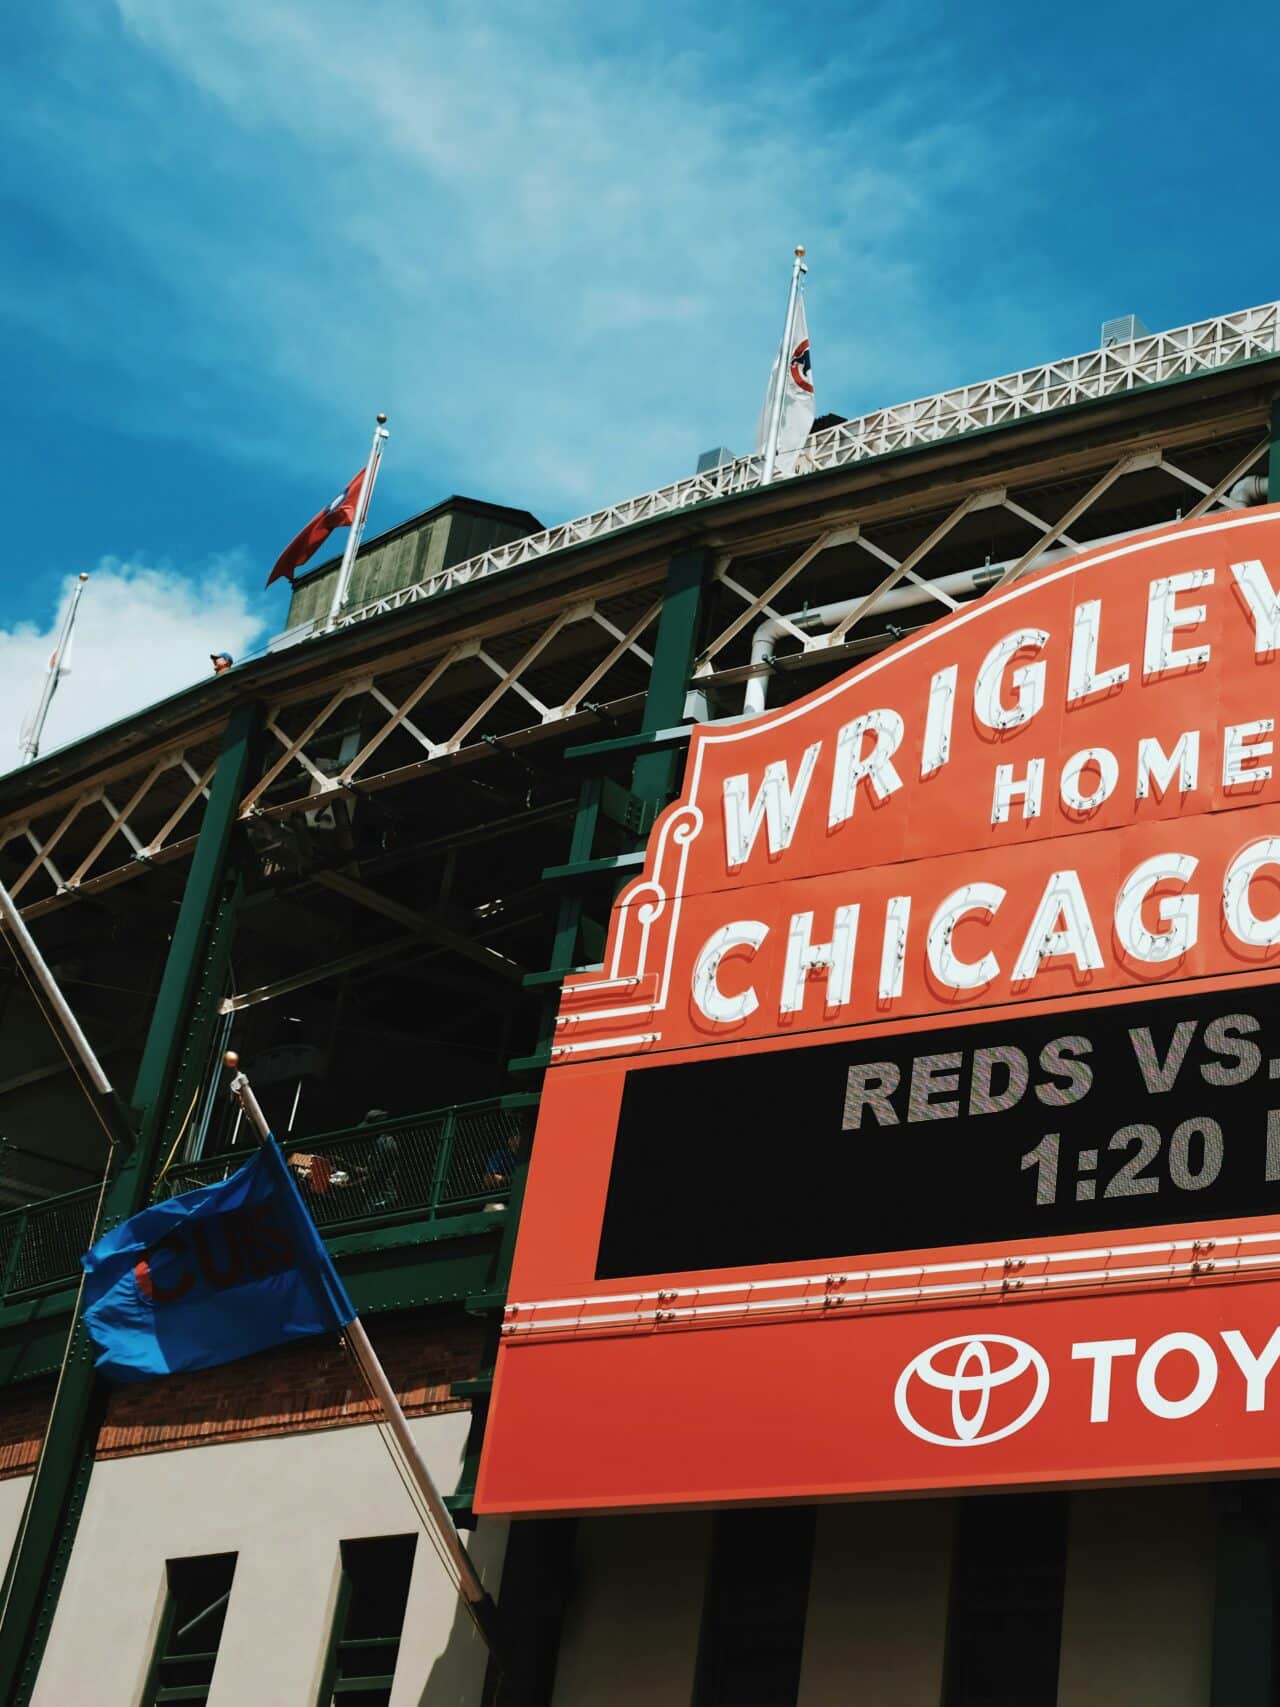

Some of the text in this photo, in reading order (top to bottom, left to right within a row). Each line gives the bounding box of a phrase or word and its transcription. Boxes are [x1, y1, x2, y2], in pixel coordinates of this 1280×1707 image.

[990, 719, 1276, 824] HOME
[841, 1035, 1095, 1131] REDS
[1019, 1116, 1225, 1206] 1:20
